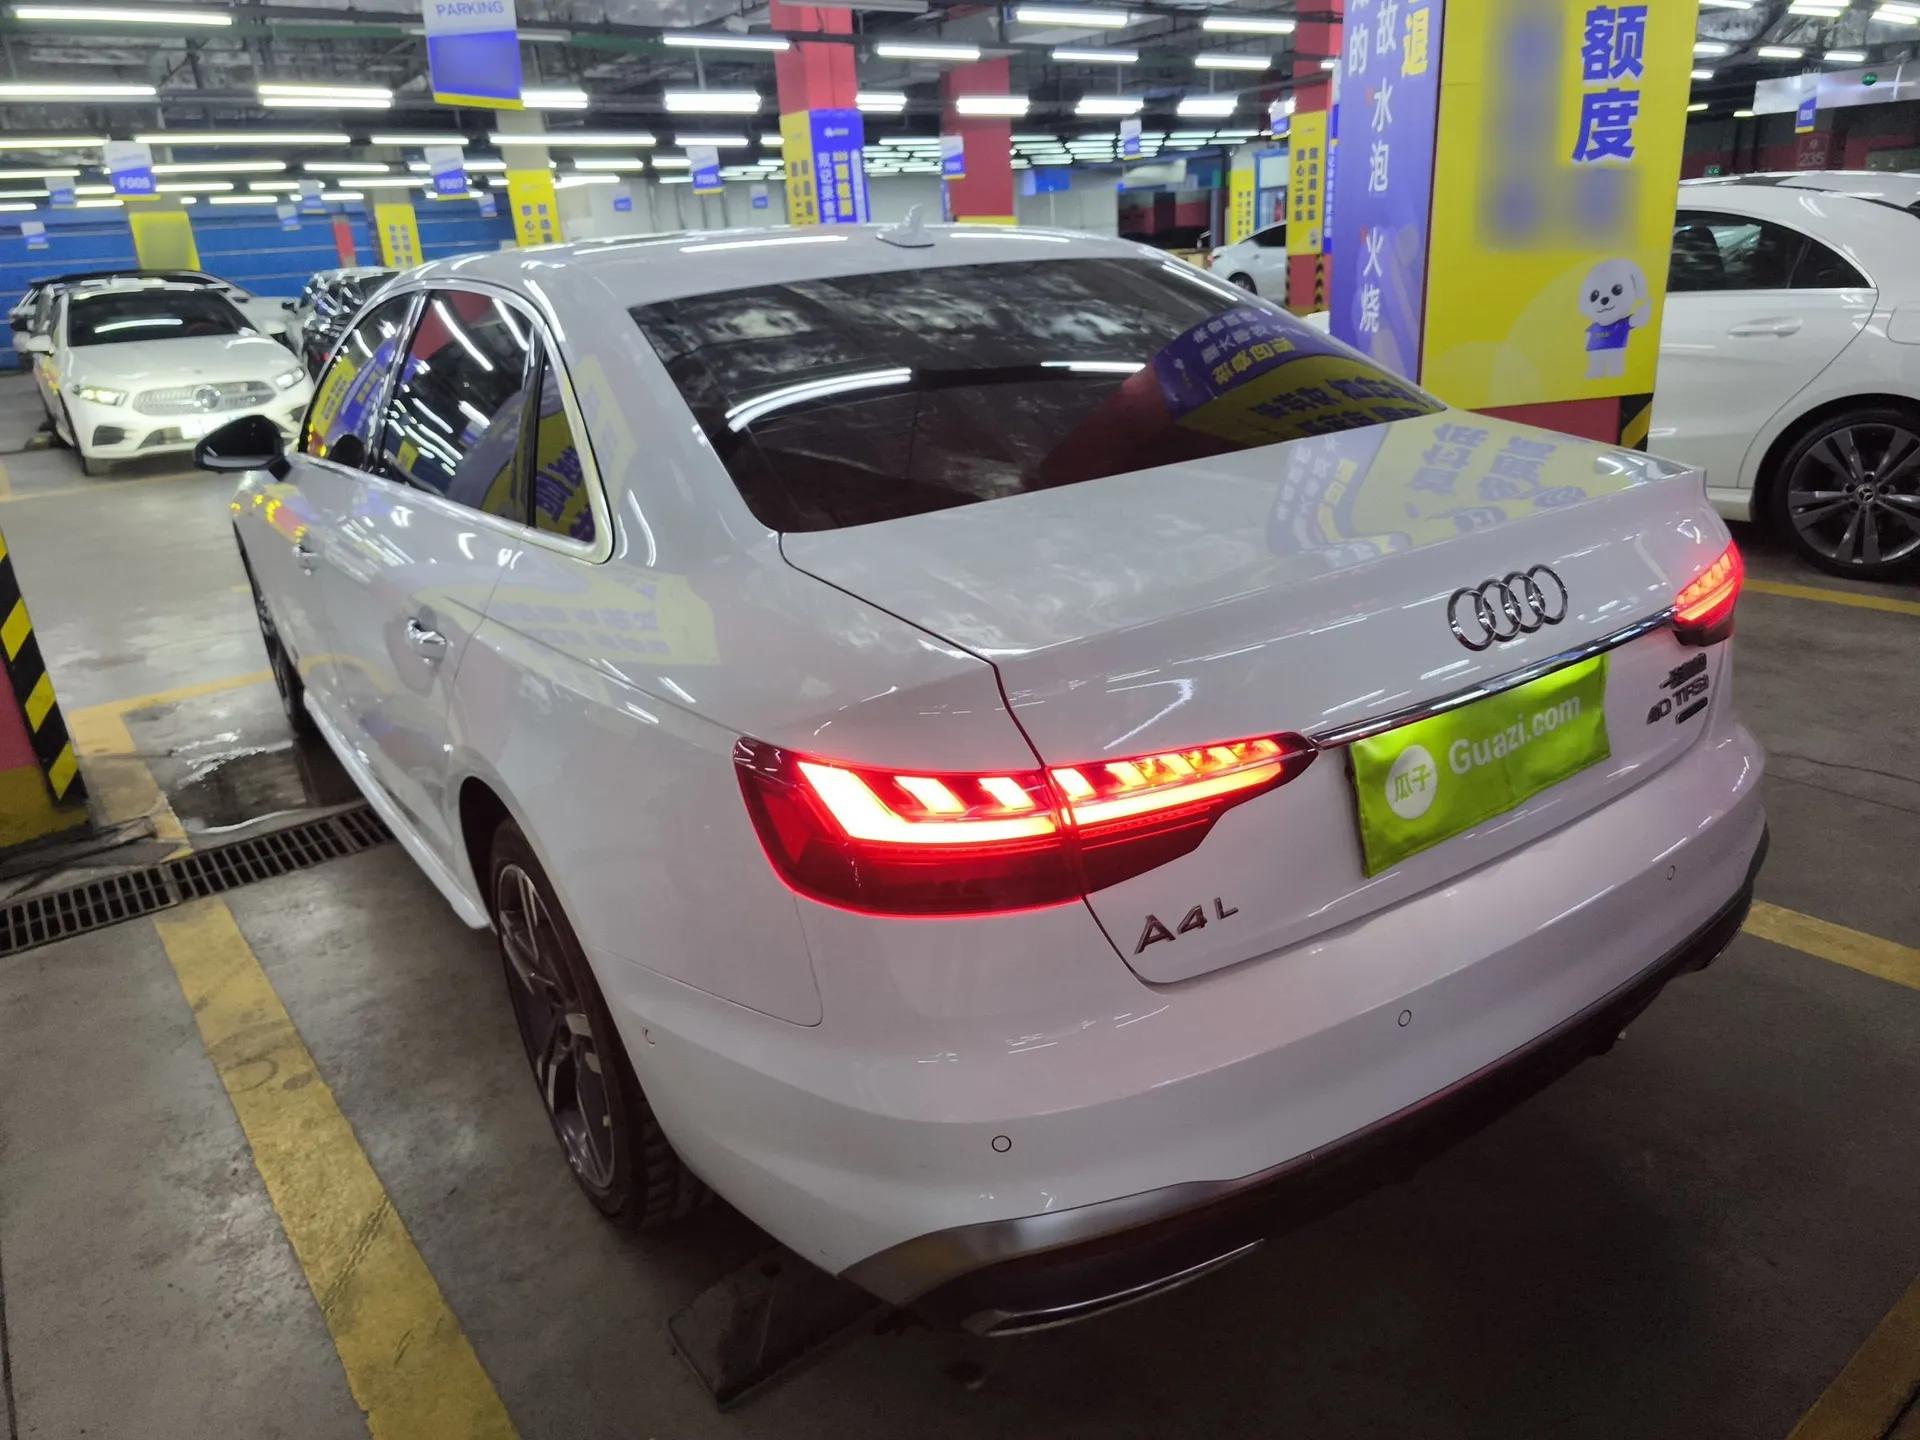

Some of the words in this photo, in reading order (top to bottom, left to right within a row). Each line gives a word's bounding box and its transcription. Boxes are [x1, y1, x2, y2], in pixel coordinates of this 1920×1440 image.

[436, 1, 505, 16] PARKING
[1571, 4, 1649, 163] 额度
[1357, 76, 1393, 193] 水泡
[1358, 226, 1384, 333] 火烧
[1646, 697, 1672, 725] 40
[1672, 673, 1710, 706] TFSI
[1448, 695, 1581, 775] Guazi.com
[1393, 763, 1431, 803] 瓜子
[1134, 896, 1240, 956] A4L
